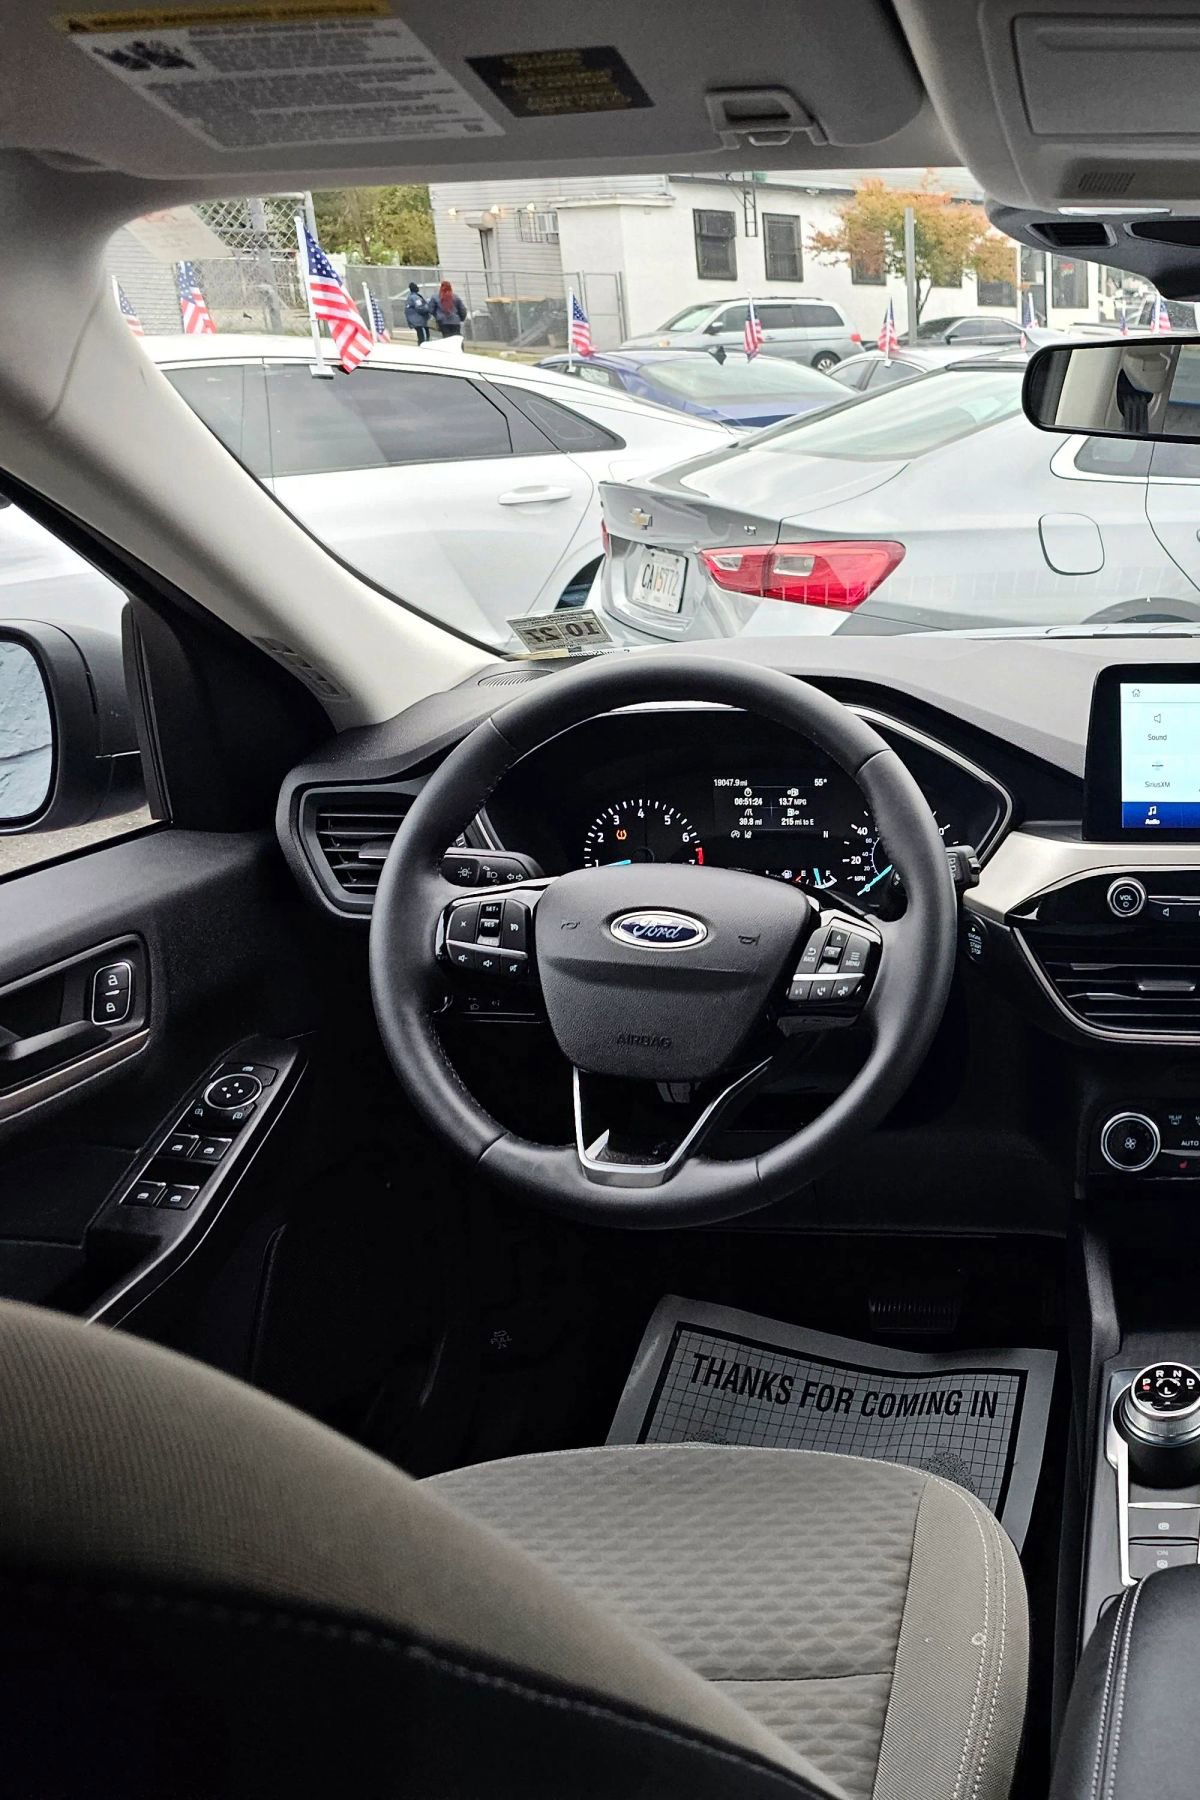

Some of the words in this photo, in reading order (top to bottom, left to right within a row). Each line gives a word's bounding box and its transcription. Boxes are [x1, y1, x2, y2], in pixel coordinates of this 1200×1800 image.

[1147, 733, 1168, 741] Sound
[637, 808, 645, 818] 4
[613, 815, 620, 825] 3
[664, 815, 671, 825] 5
[857, 827, 868, 835] 40
[597, 832, 604, 843] 2
[682, 832, 690, 842] 6
[851, 856, 861, 864] 20
[633, 919, 683, 939] Ford
[617, 1033, 673, 1048] AIRBAG
[1155, 1370, 1165, 1378] R
[1172, 1370, 1182, 1378] N
[690, 1352, 794, 1405] THANKS
[800, 1380, 852, 1415] FOR
[860, 1389, 963, 1419] COMING
[970, 1390, 999, 1419] IN
[1142, 1378, 1151, 1386] P
[1186, 1378, 1195, 1386] D
[1164, 1386, 1171, 1395] L
